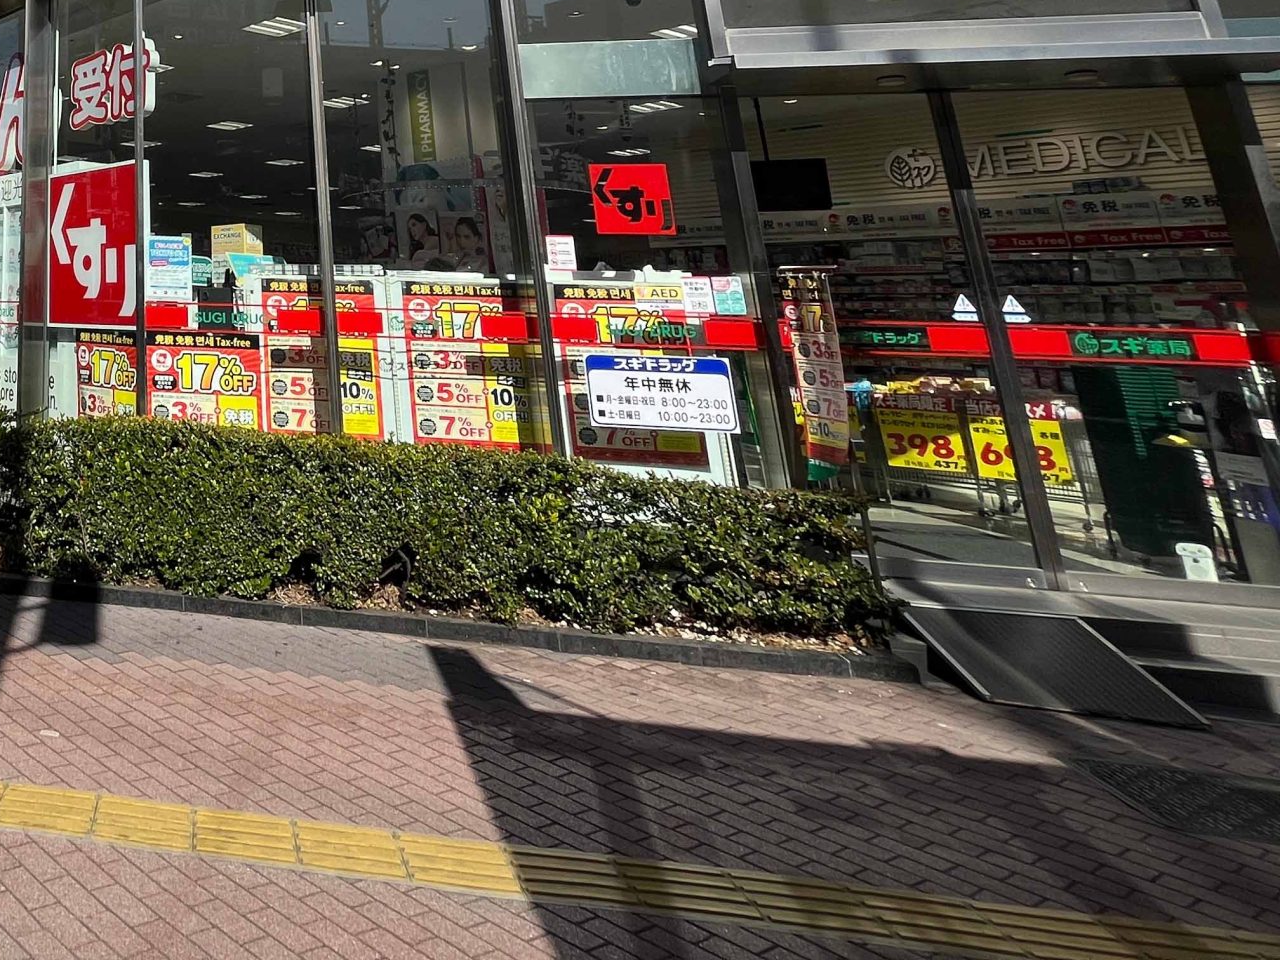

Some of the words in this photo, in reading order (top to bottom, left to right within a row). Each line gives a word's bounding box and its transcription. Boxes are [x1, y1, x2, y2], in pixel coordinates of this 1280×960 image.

[593, 168, 672, 231] くすり
[51, 183, 136, 317] くすり
[335, 283, 365, 293] ax-free
[650, 288, 678, 299] AED
[195, 311, 226, 324] SUGI
[650, 323, 696, 338] DRUG
[216, 337, 251, 348] Tax-free
[1100, 336, 1191, 356] スギ薬局
[613, 358, 698, 371] スギドラッグ
[220, 374, 254, 392] OFF
[624, 376, 692, 393] 年中無休
[886, 432, 955, 460] 398
[934, 460, 958, 470] 437
